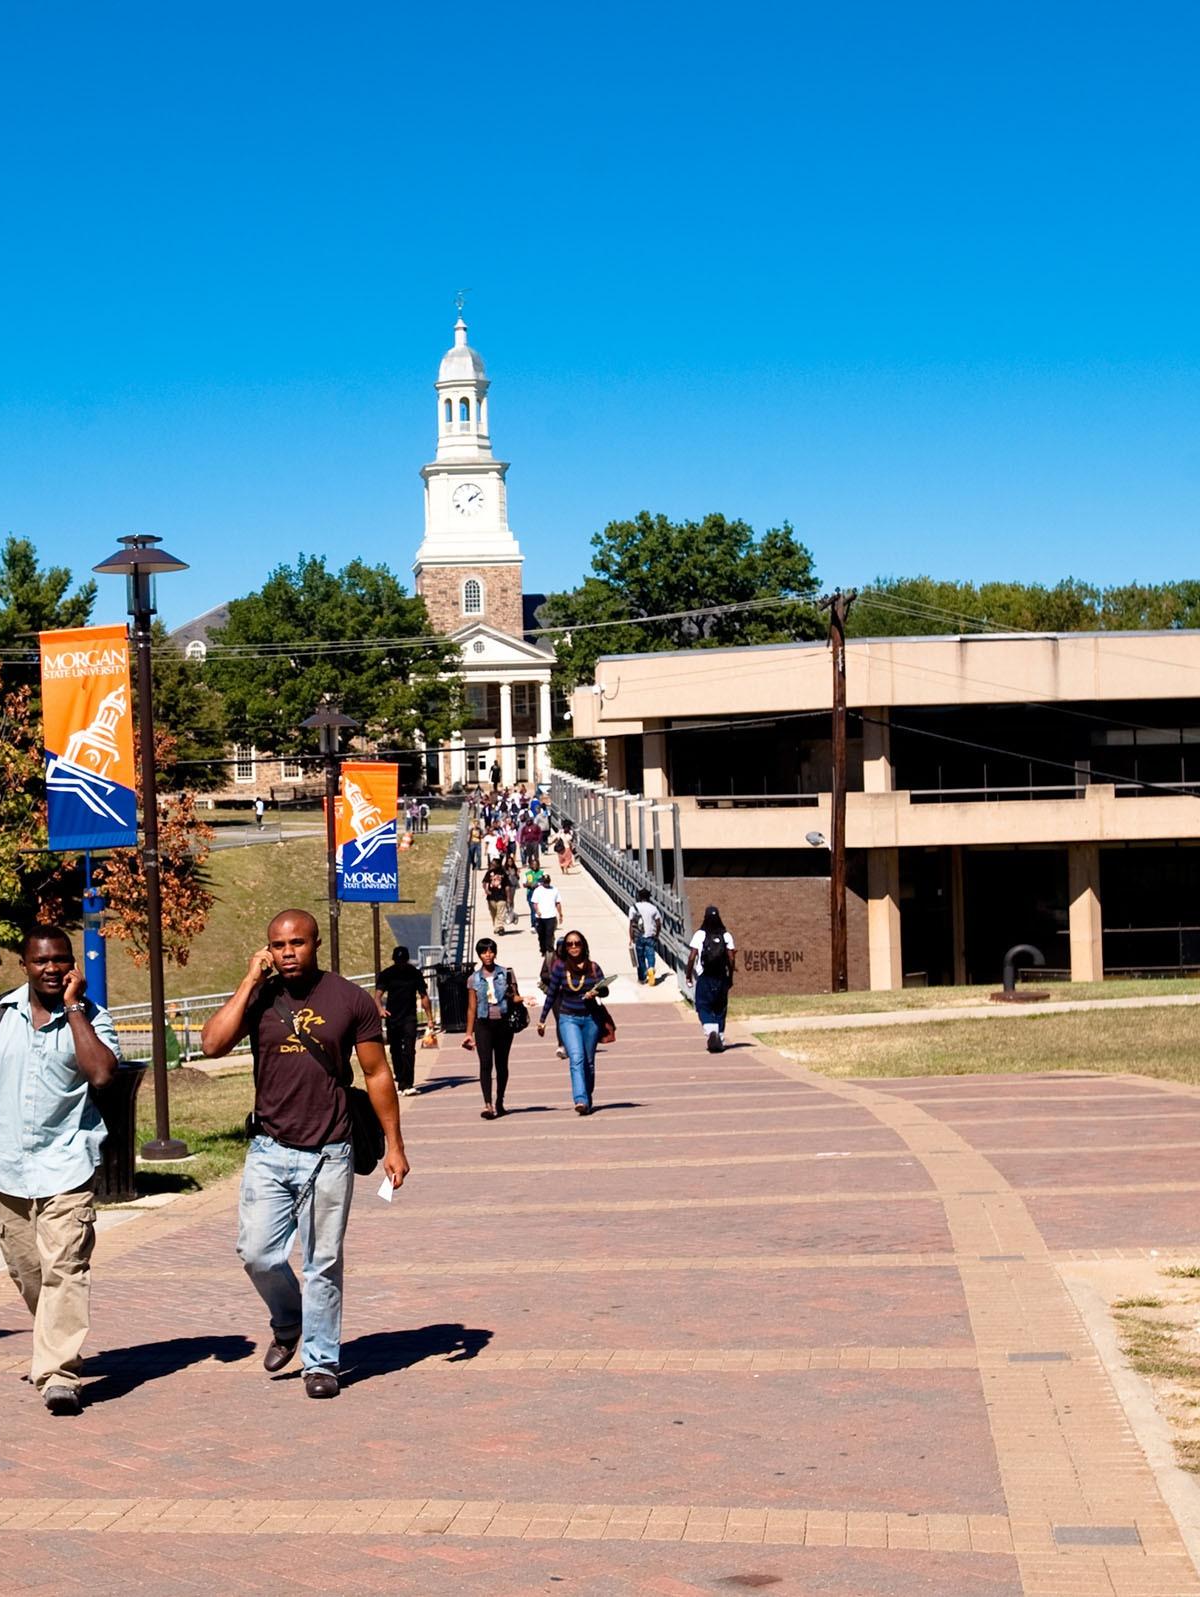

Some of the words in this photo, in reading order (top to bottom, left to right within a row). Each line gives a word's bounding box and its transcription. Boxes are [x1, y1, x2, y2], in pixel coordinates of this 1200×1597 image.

[44, 648, 127, 671] MORGAN
[44, 670, 70, 680] STATE
[71, 664, 127, 678] UNIVERSITY
[344, 872, 397, 883] MORGAN
[744, 961, 793, 972] CENTER
